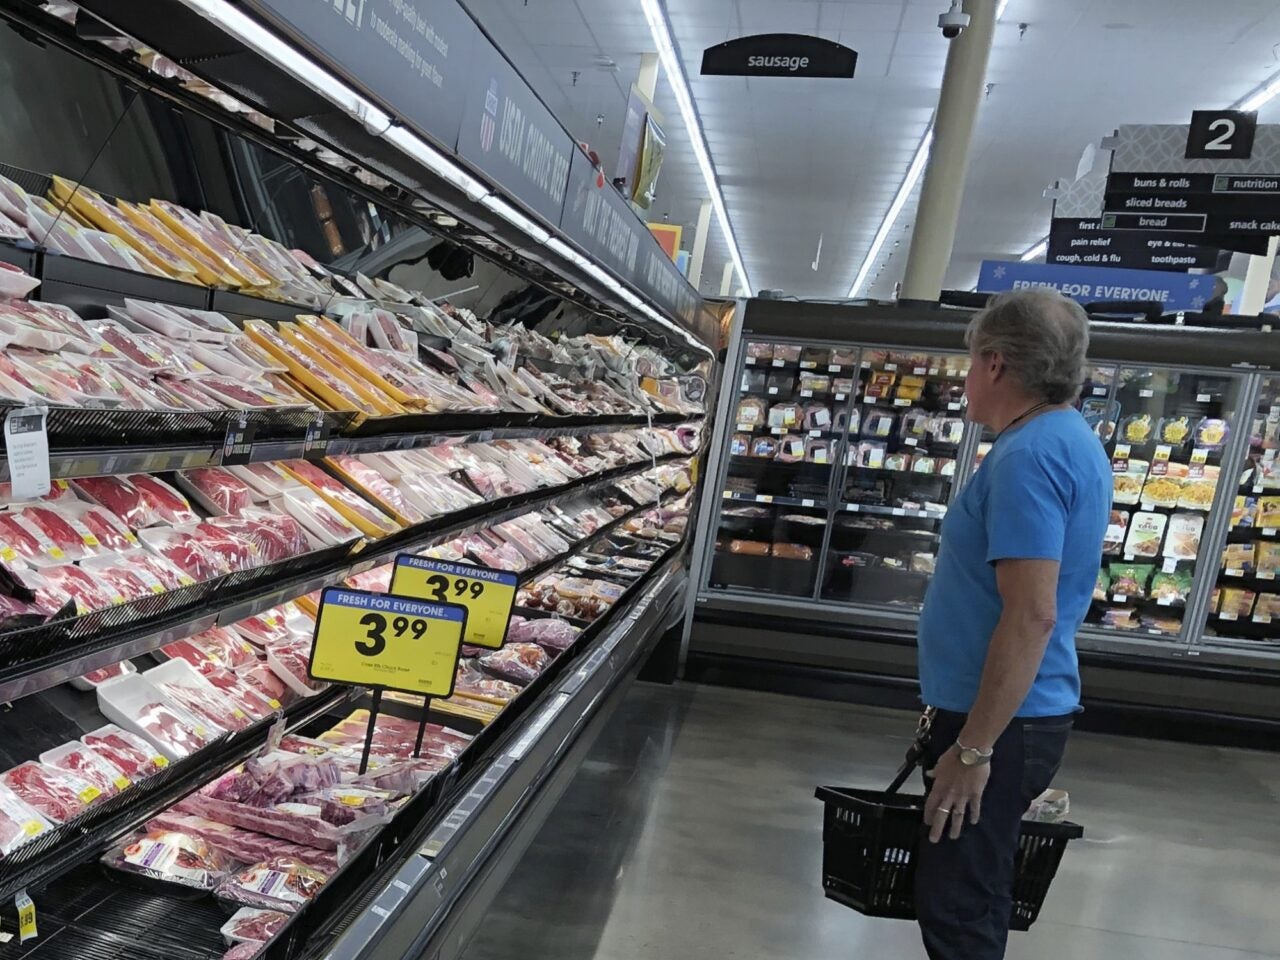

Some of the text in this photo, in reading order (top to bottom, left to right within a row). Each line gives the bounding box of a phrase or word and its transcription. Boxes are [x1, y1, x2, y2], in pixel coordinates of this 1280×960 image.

[748, 56, 809, 71] sausage
[1204, 118, 1236, 151] 2
[500, 96, 526, 167] USDA
[523, 122, 554, 191] CHOICE
[1134, 178, 1191, 188] buns & rolls
[1233, 179, 1279, 189] nutrition
[1125, 198, 1187, 209] sliced breads
[1079, 222, 1095, 230] first
[1139, 217, 1168, 227] bread
[1230, 221, 1258, 230] snack
[1071, 238, 1111, 248] pain relief
[1147, 240, 1163, 248] eye
[1056, 254, 1082, 263] cough,
[1084, 254, 1101, 262] cold
[1102, 254, 1108, 262] &
[1151, 256, 1196, 264] toothpaste
[1061, 283, 1090, 297] FOR
[1095, 285, 1169, 302] EVERYONE
[408, 558, 498, 580] FRESH FOR EVERYONE
[337, 594, 443, 617] FRESH FOR EVERYONE
